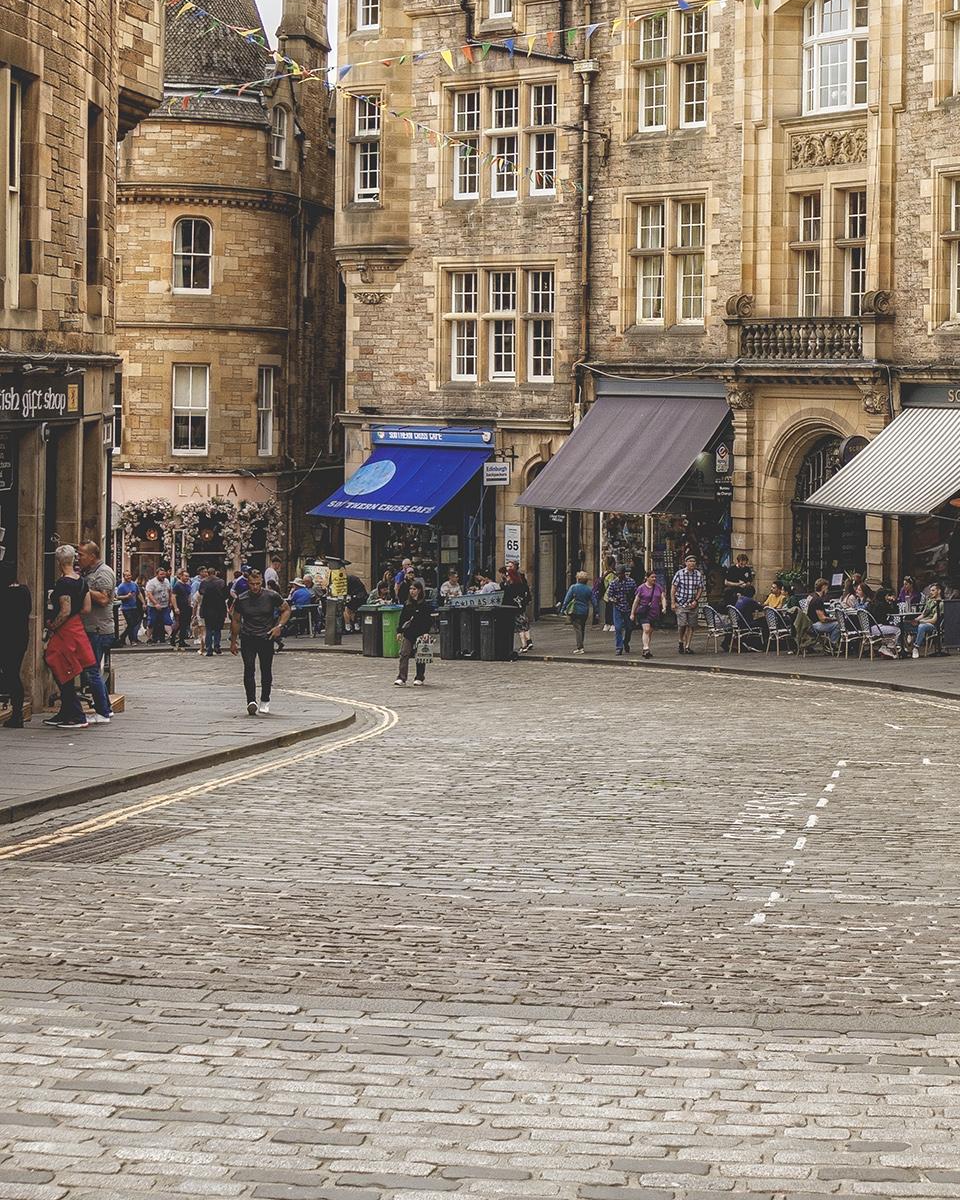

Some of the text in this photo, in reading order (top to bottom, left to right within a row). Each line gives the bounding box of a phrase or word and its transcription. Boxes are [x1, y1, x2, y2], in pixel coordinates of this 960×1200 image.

[0, 387, 66, 417] ish gift shop
[413, 432, 428, 440] CROSS
[177, 483, 238, 497] LAILA
[377, 503, 410, 512] CROSS
[506, 540, 519, 551] 65
